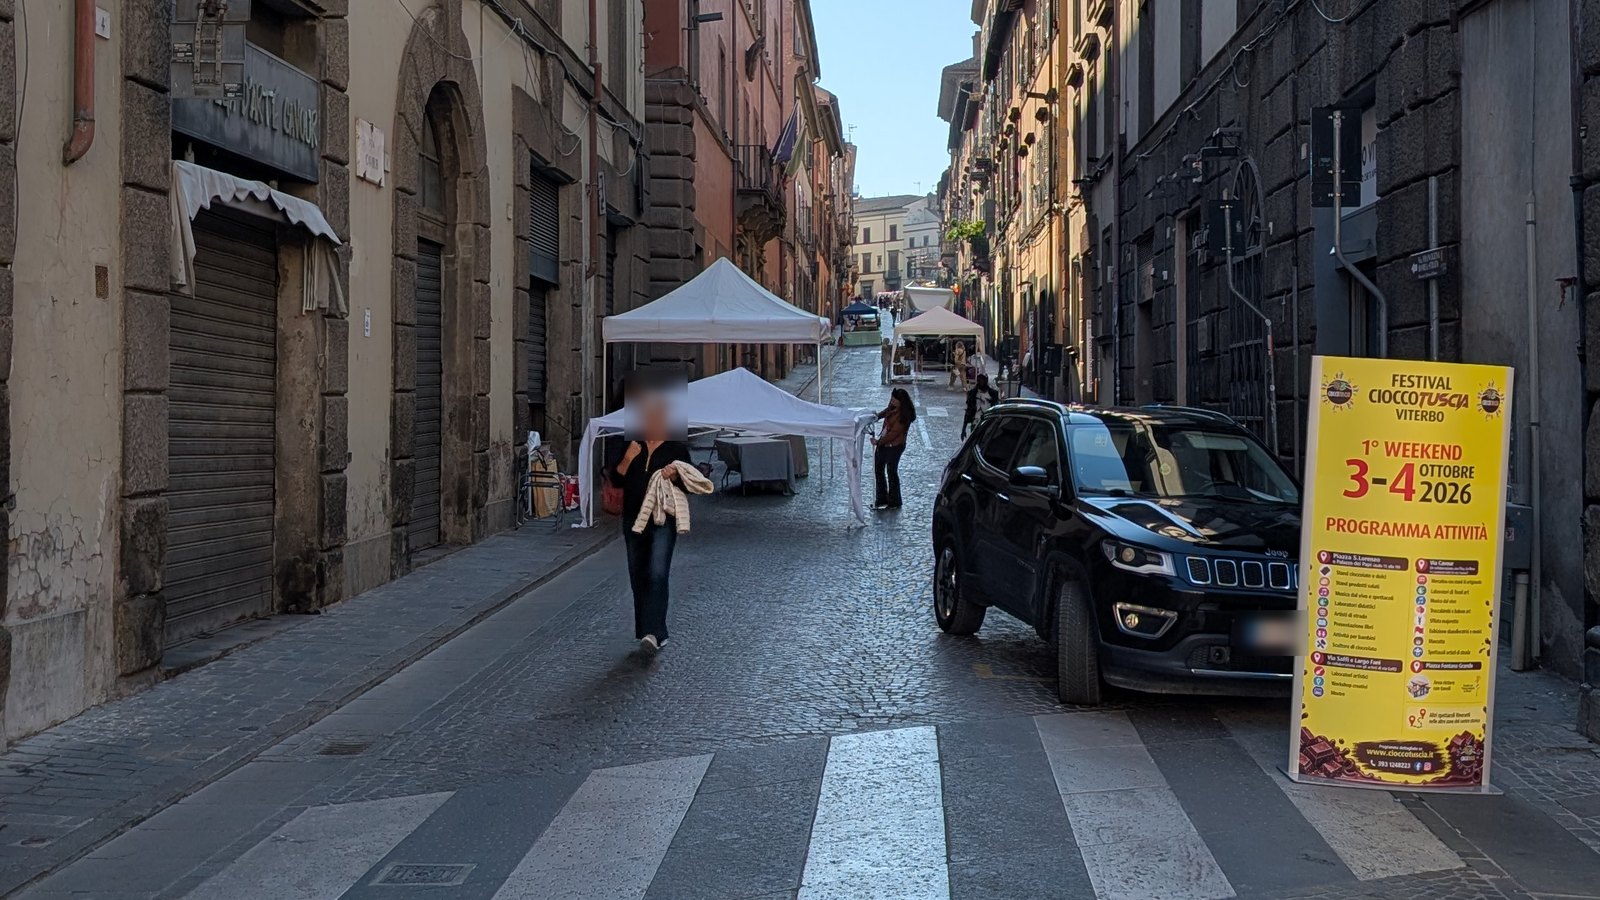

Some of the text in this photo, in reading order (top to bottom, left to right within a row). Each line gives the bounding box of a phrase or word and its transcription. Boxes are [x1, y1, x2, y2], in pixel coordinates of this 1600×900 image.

[282, 97, 318, 149] CAVOUR
[1392, 374, 1452, 390] FESTIVAL
[1368, 388, 1469, 410] CIOCCOTUSCIA
[1396, 408, 1444, 422] VITERBO
[1362, 440, 1462, 460] 1° WEEKEND
[1342, 458, 1416, 502] 3-4
[1419, 464, 1475, 480] OTTOBRE
[1418, 481, 1472, 504] 2026
[1326, 517, 1488, 540] PROGRAMMA ATTIVITÀ
[1265, 547, 1289, 558] Jeep
[1366, 749, 1434, 758] www.cioccotuscia.it
